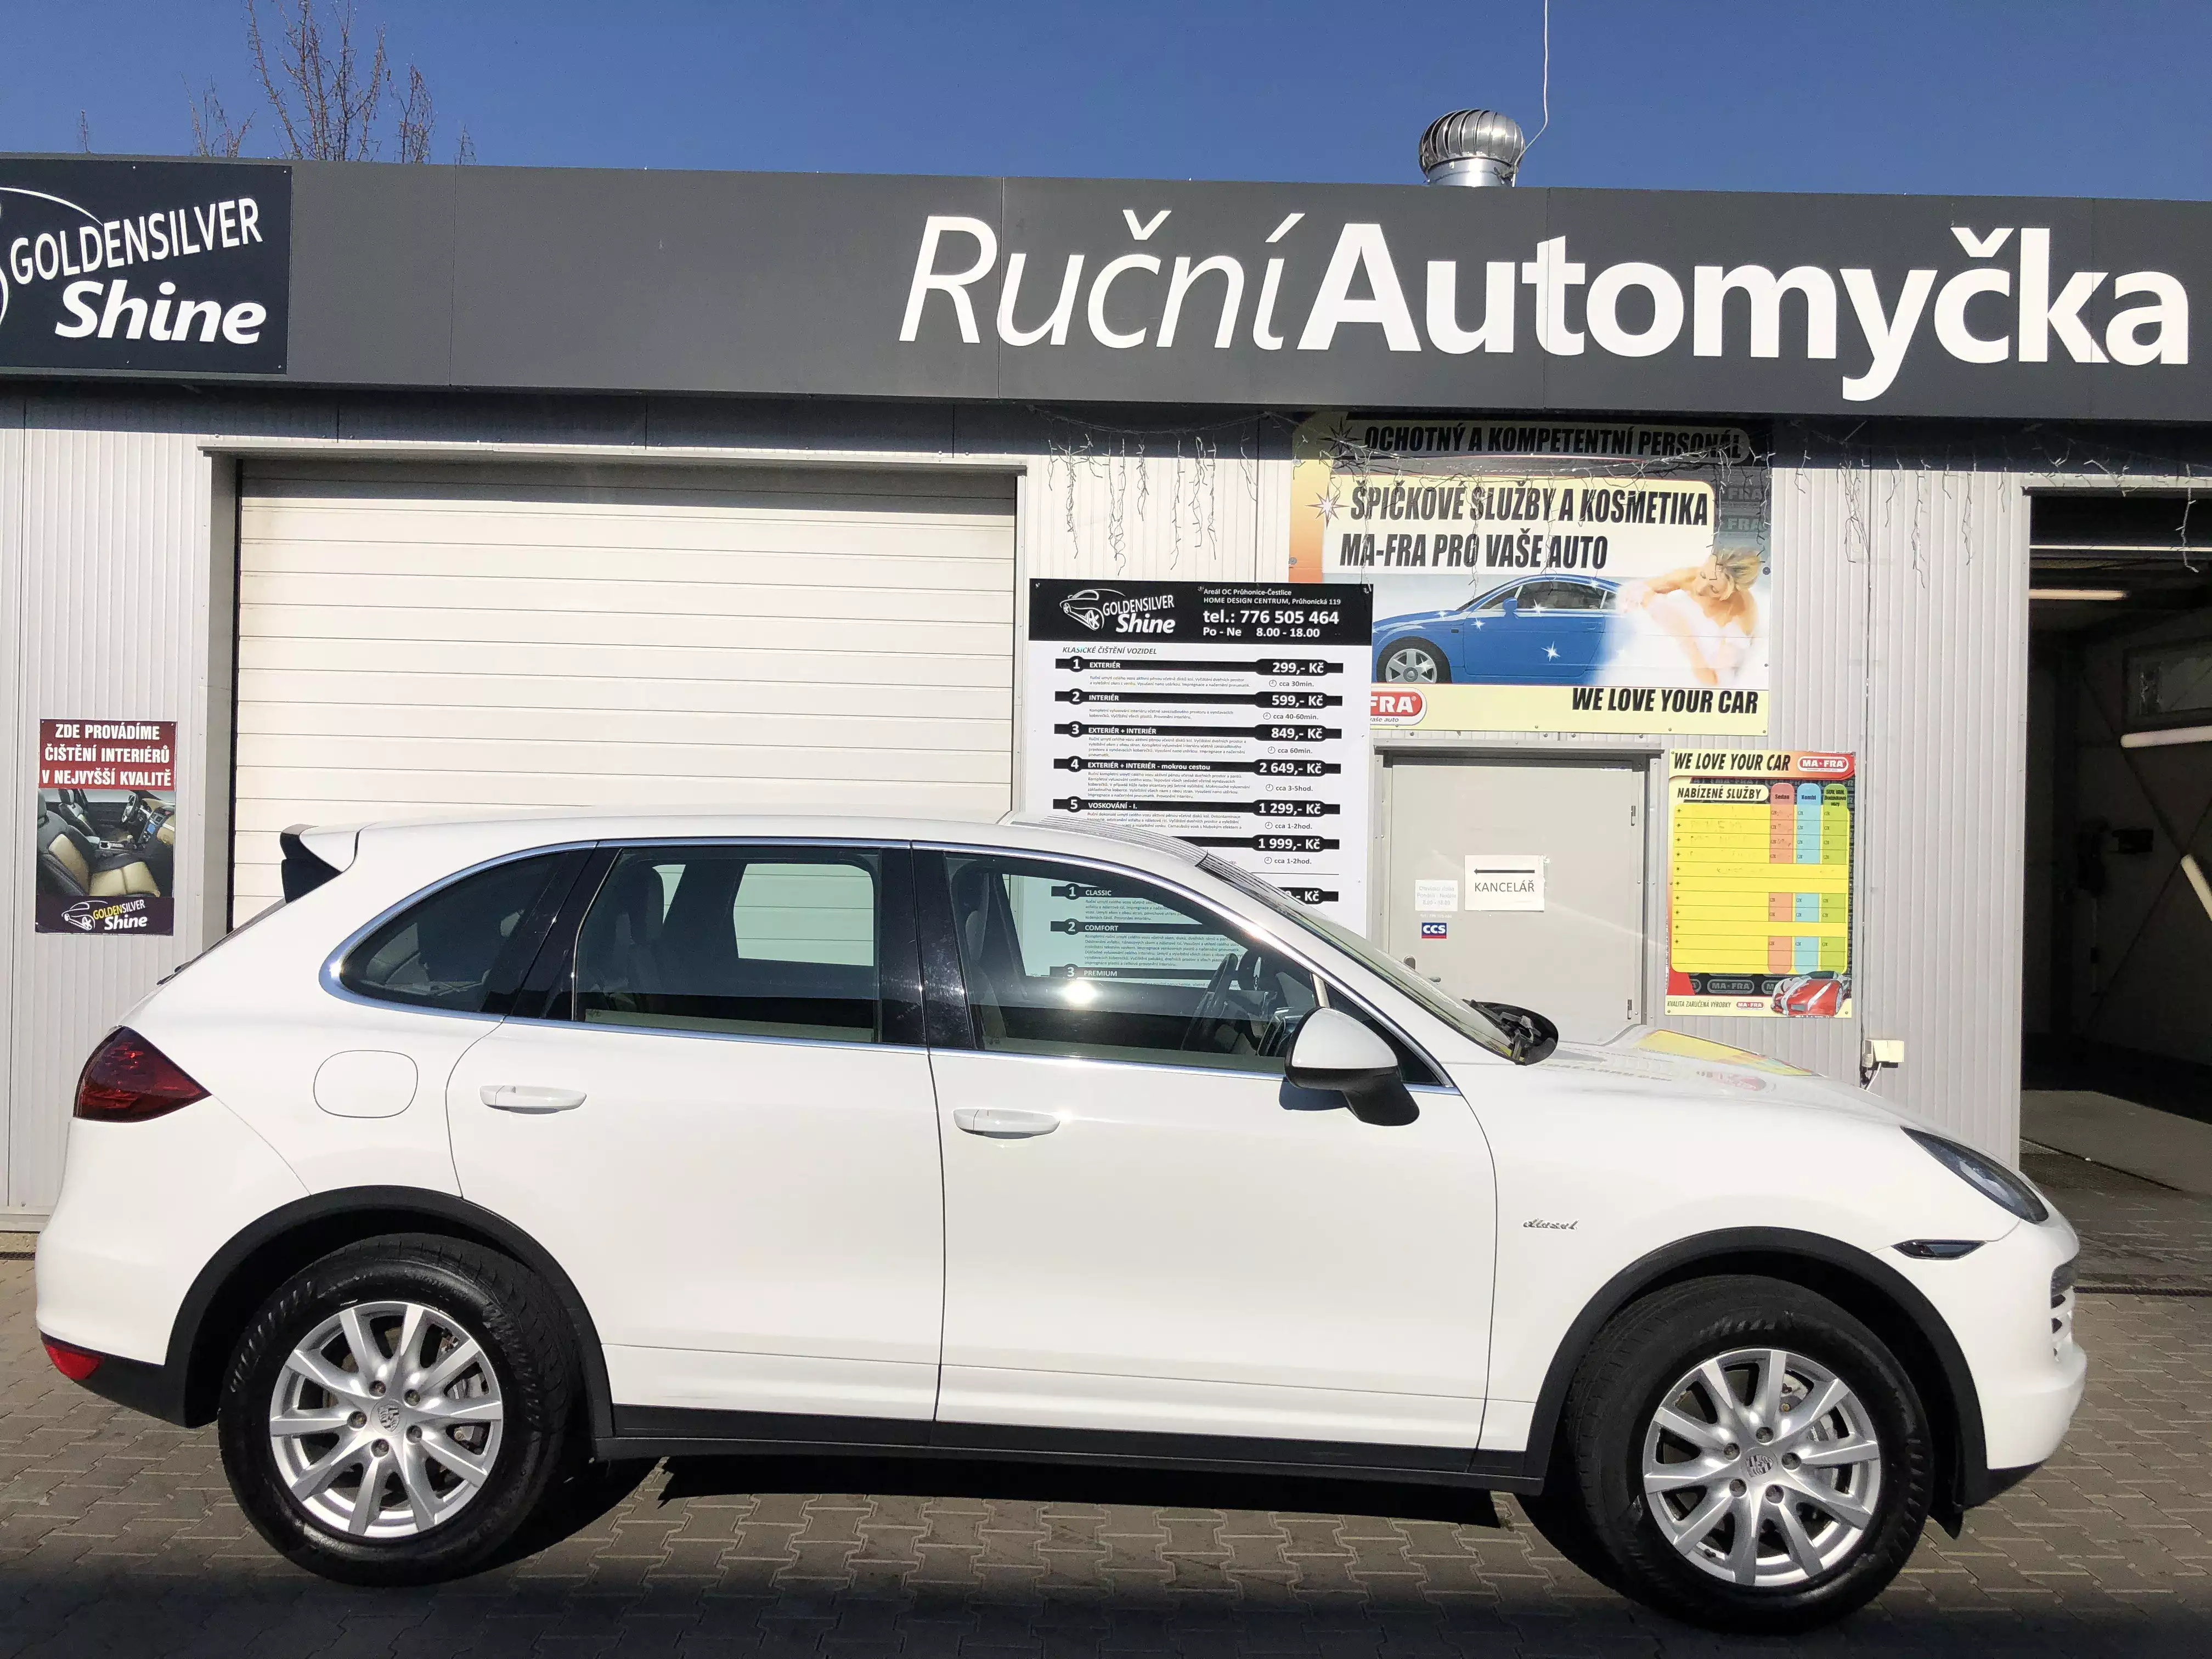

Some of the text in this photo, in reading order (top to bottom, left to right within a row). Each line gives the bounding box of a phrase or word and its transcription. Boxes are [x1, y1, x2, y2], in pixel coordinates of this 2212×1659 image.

[10, 198, 263, 285] GOLDENSILVER
[55, 279, 267, 345] Shine
[899, 209, 2191, 402] Ruční Automyčka
[1365, 422, 1741, 460] OCHOTNÝ A KOMPETENTNÍ PERSONÁL
[1470, 480, 1555, 522] SLUŽBY
[1559, 492, 1575, 522] A
[1581, 489, 1708, 526] KOSMETIKA
[1340, 527, 1608, 569] MA-FRA PRO VAŠE AUTO
[1103, 595, 1175, 616] GOLDENSILVER
[1116, 613, 1175, 634] Shine
[1203, 610, 1339, 624] tel.: 776 505 464
[1203, 627, 1217, 636] Po
[1227, 628, 1242, 636] Ne
[1256, 628, 1280, 636] 8.00
[1290, 628, 1320, 637] 18.00
[1098, 646, 1124, 654] ČIŠTĚNÍ
[1073, 659, 1080, 669] 1
[1273, 662, 1305, 675] 299,-
[1310, 662, 1324, 673] Kč
[1073, 691, 1080, 702] 2
[1272, 695, 1304, 707] 599,-
[1308, 695, 1323, 706] Kč
[1573, 688, 1758, 715] WE LOVE YOUR CAR
[55, 722, 160, 740] ZDE PROVÁDÍME
[1071, 724, 1079, 734] 3
[1271, 727, 1304, 740] 849,-
[1308, 728, 1322, 739] Kč
[45, 743, 170, 763] ČIŠTĚNÍ INTERIÉRŮ
[1071, 759, 1079, 769] 4
[1260, 763, 1267, 772] 2
[1271, 763, 1303, 775] 649,-
[1307, 763, 1322, 774] Kč
[1673, 752, 1791, 771] WE LOVE YOUR CAR
[42, 768, 171, 786] V NEJVYŠŠÍ KVALITĚ
[1677, 785, 1762, 799] NABÍZENÉ SLUŽBY
[1070, 799, 1077, 809] 5
[1259, 803, 1266, 813] 1
[1270, 803, 1302, 816] 299,-
[1306, 803, 1321, 814] Kč
[1259, 838, 1320, 850] 1 999,- Kč
[1069, 887, 1076, 896] 1
[1475, 880, 1534, 892] KANCELÁŘ
[1305, 890, 1319, 901] Kč
[93, 899, 145, 919] GOLDENSILVER
[104, 916, 148, 930] Shine
[1068, 922, 1075, 932] 2
[1423, 924, 1446, 934] CCS
[1067, 967, 1075, 977] 3
